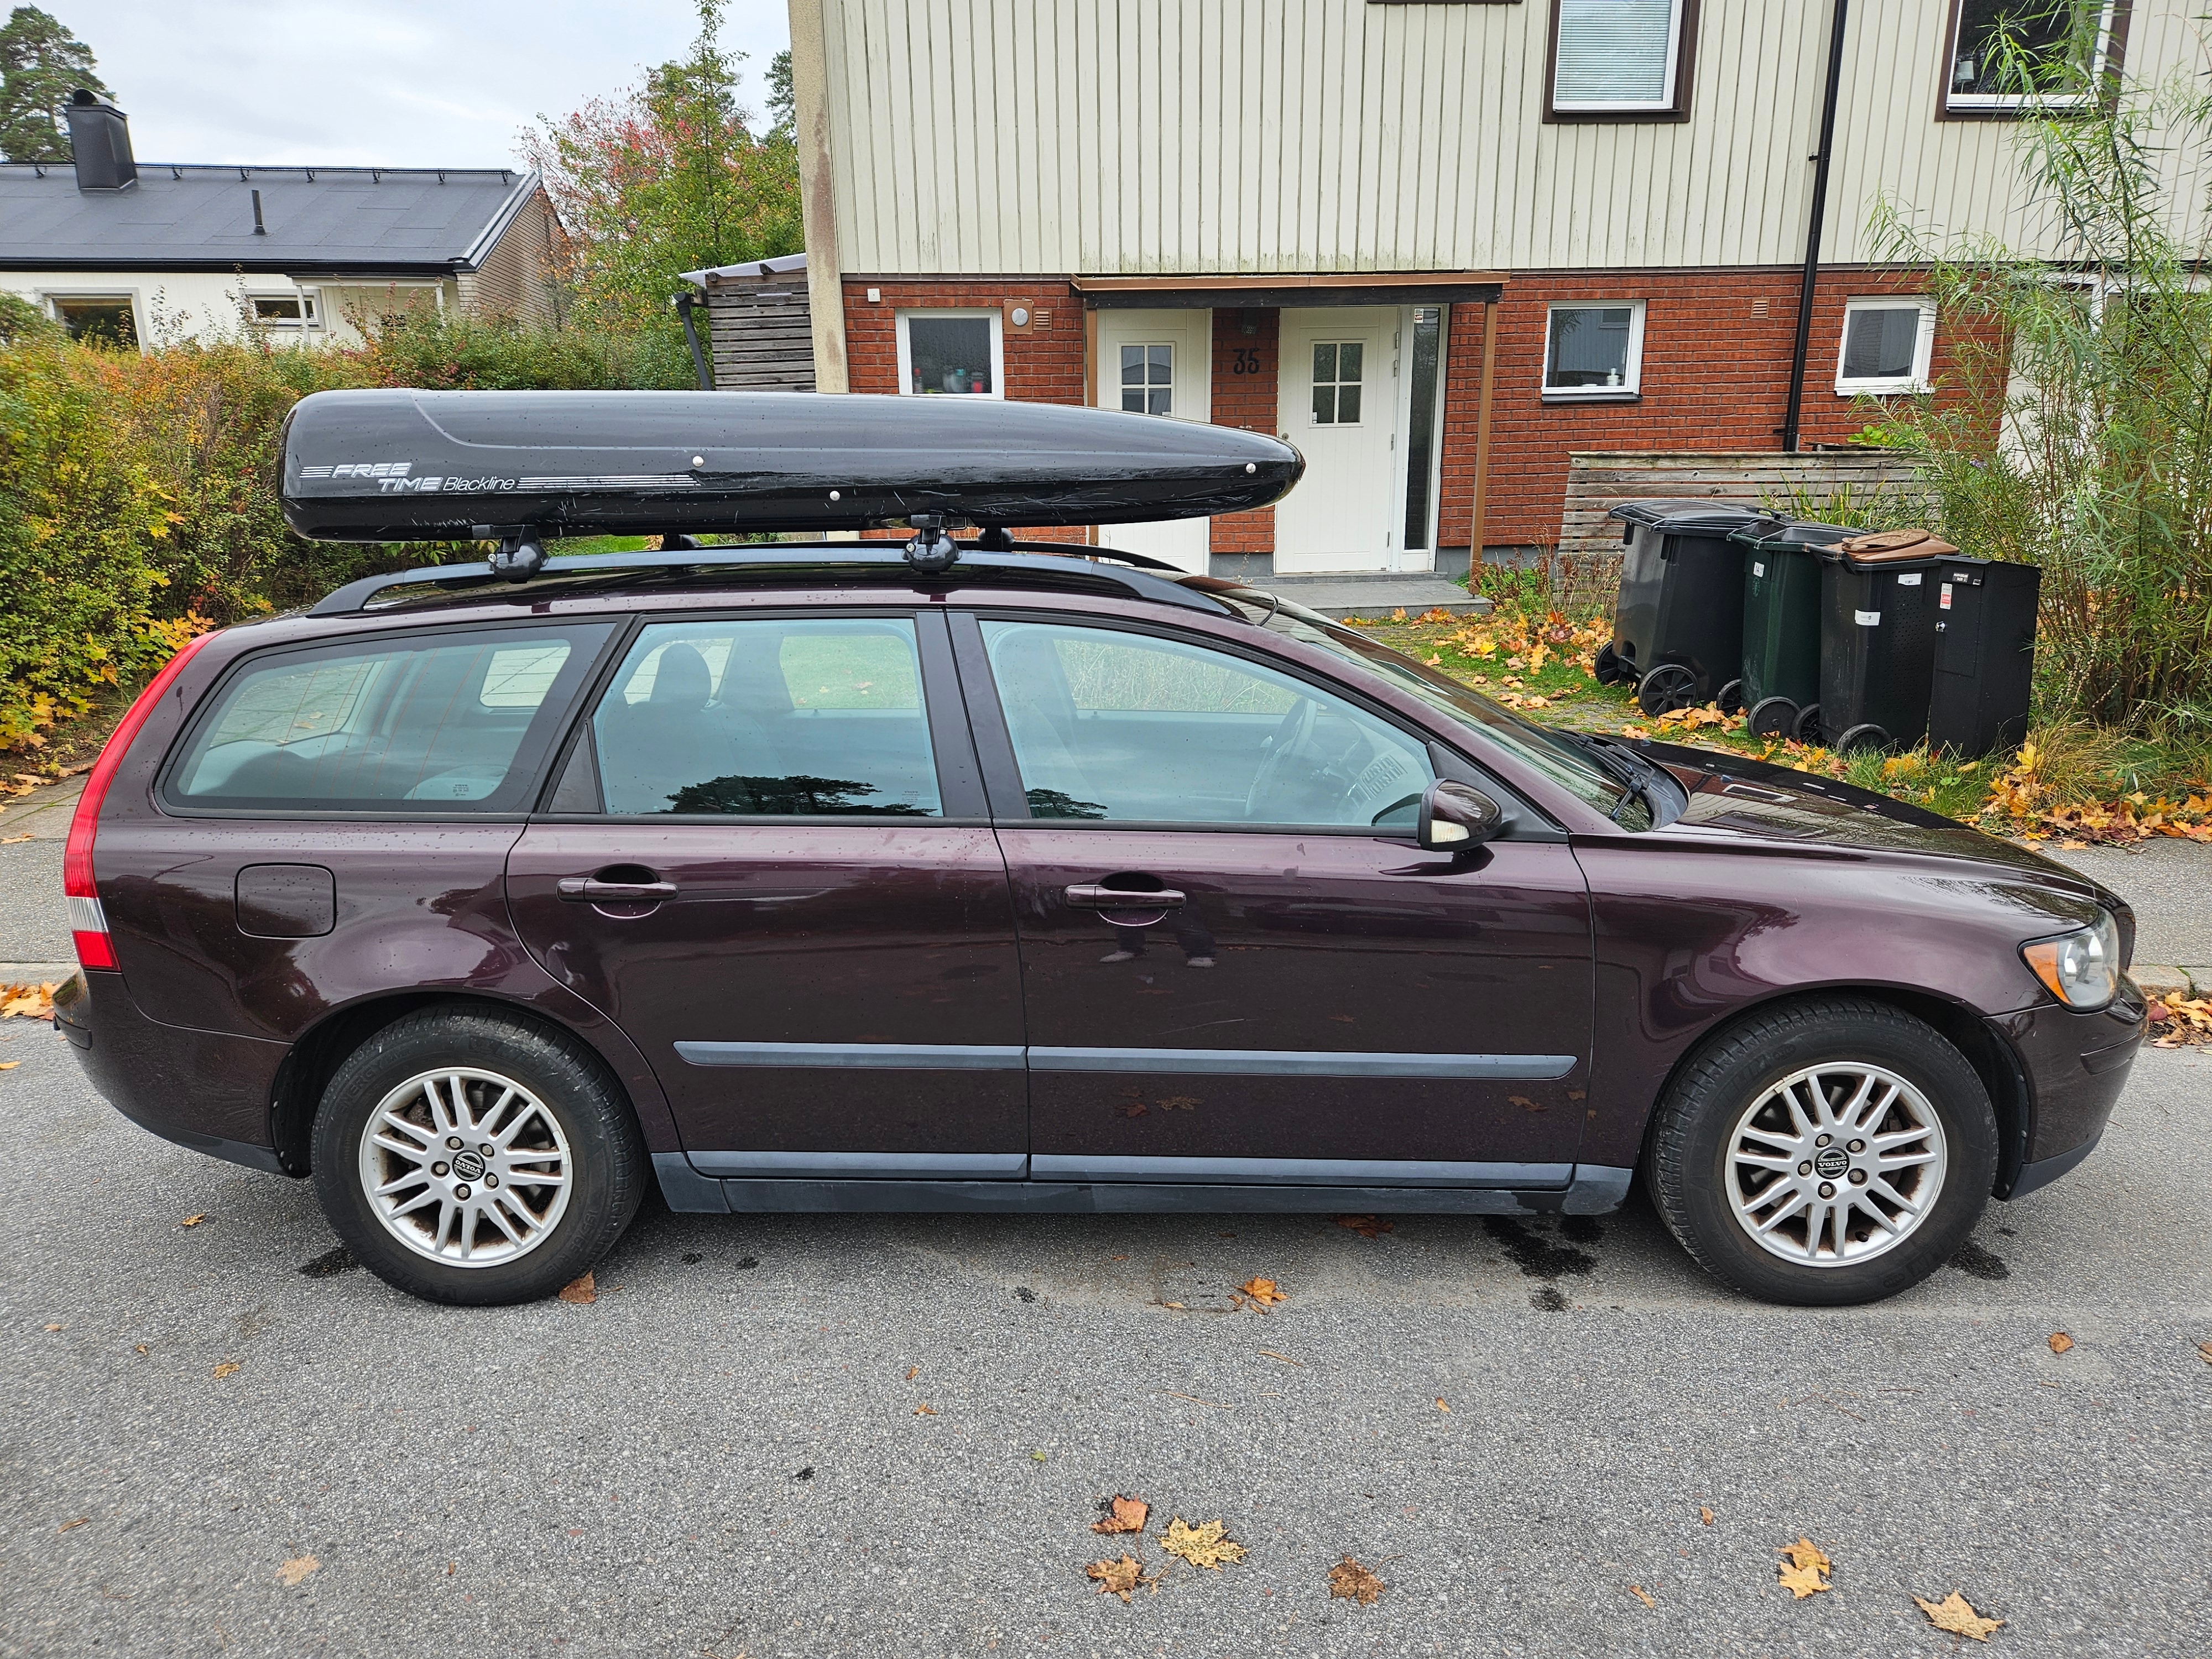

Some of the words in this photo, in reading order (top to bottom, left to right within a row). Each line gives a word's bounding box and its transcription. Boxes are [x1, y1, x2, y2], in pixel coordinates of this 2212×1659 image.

[1233, 348, 1260, 375] 35
[332, 462, 413, 478] FREE
[378, 477, 444, 492] TIME
[443, 476, 515, 491] Blackline
[455, 1160, 482, 1174] VOLVO
